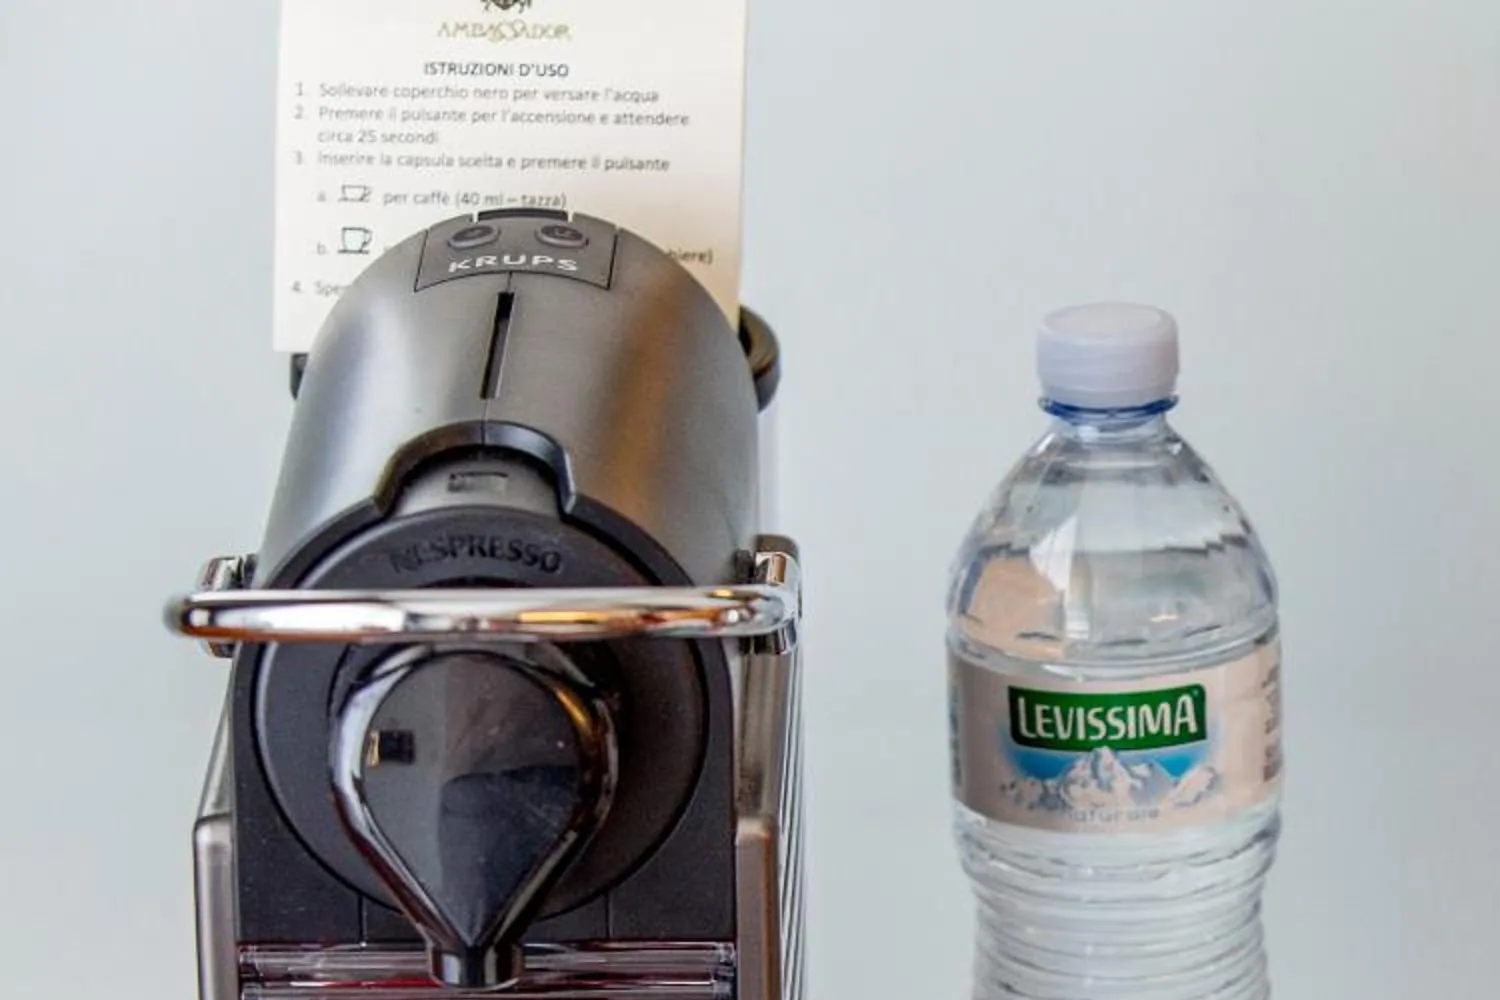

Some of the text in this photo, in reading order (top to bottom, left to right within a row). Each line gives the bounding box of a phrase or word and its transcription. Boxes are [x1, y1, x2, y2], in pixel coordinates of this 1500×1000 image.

[424, 62, 569, 77] ISTRUZIONI D'USO
[319, 82, 389, 98] Sollevare
[393, 83, 469, 101] coperchio
[473, 88, 509, 99] nero
[513, 89, 538, 103] per
[544, 90, 600, 102] versare
[605, 87, 659, 103] l'acqua
[319, 106, 385, 121] Premere
[389, 107, 397, 121] il
[401, 107, 467, 123] pulsante
[471, 110, 497, 124] per
[501, 109, 596, 124] l'accensione
[600, 114, 609, 124] e
[613, 112, 690, 126] attendere
[317, 130, 438, 145] circa 25 secondi
[318, 151, 375, 166] Inserire
[380, 152, 392, 166] la
[397, 153, 456, 169] capsula
[459, 154, 503, 168] scelta
[507, 158, 516, 168] e
[521, 157, 587, 171] premere
[605, 157, 670, 172] pulsante
[383, 193, 409, 207] per
[455, 191, 481, 208] (40
[485, 191, 502, 206] ml
[448, 254, 578, 272] KRUPS
[389, 534, 562, 573] NESPRESSO
[1017, 693, 1198, 741] LEVISSIMA
